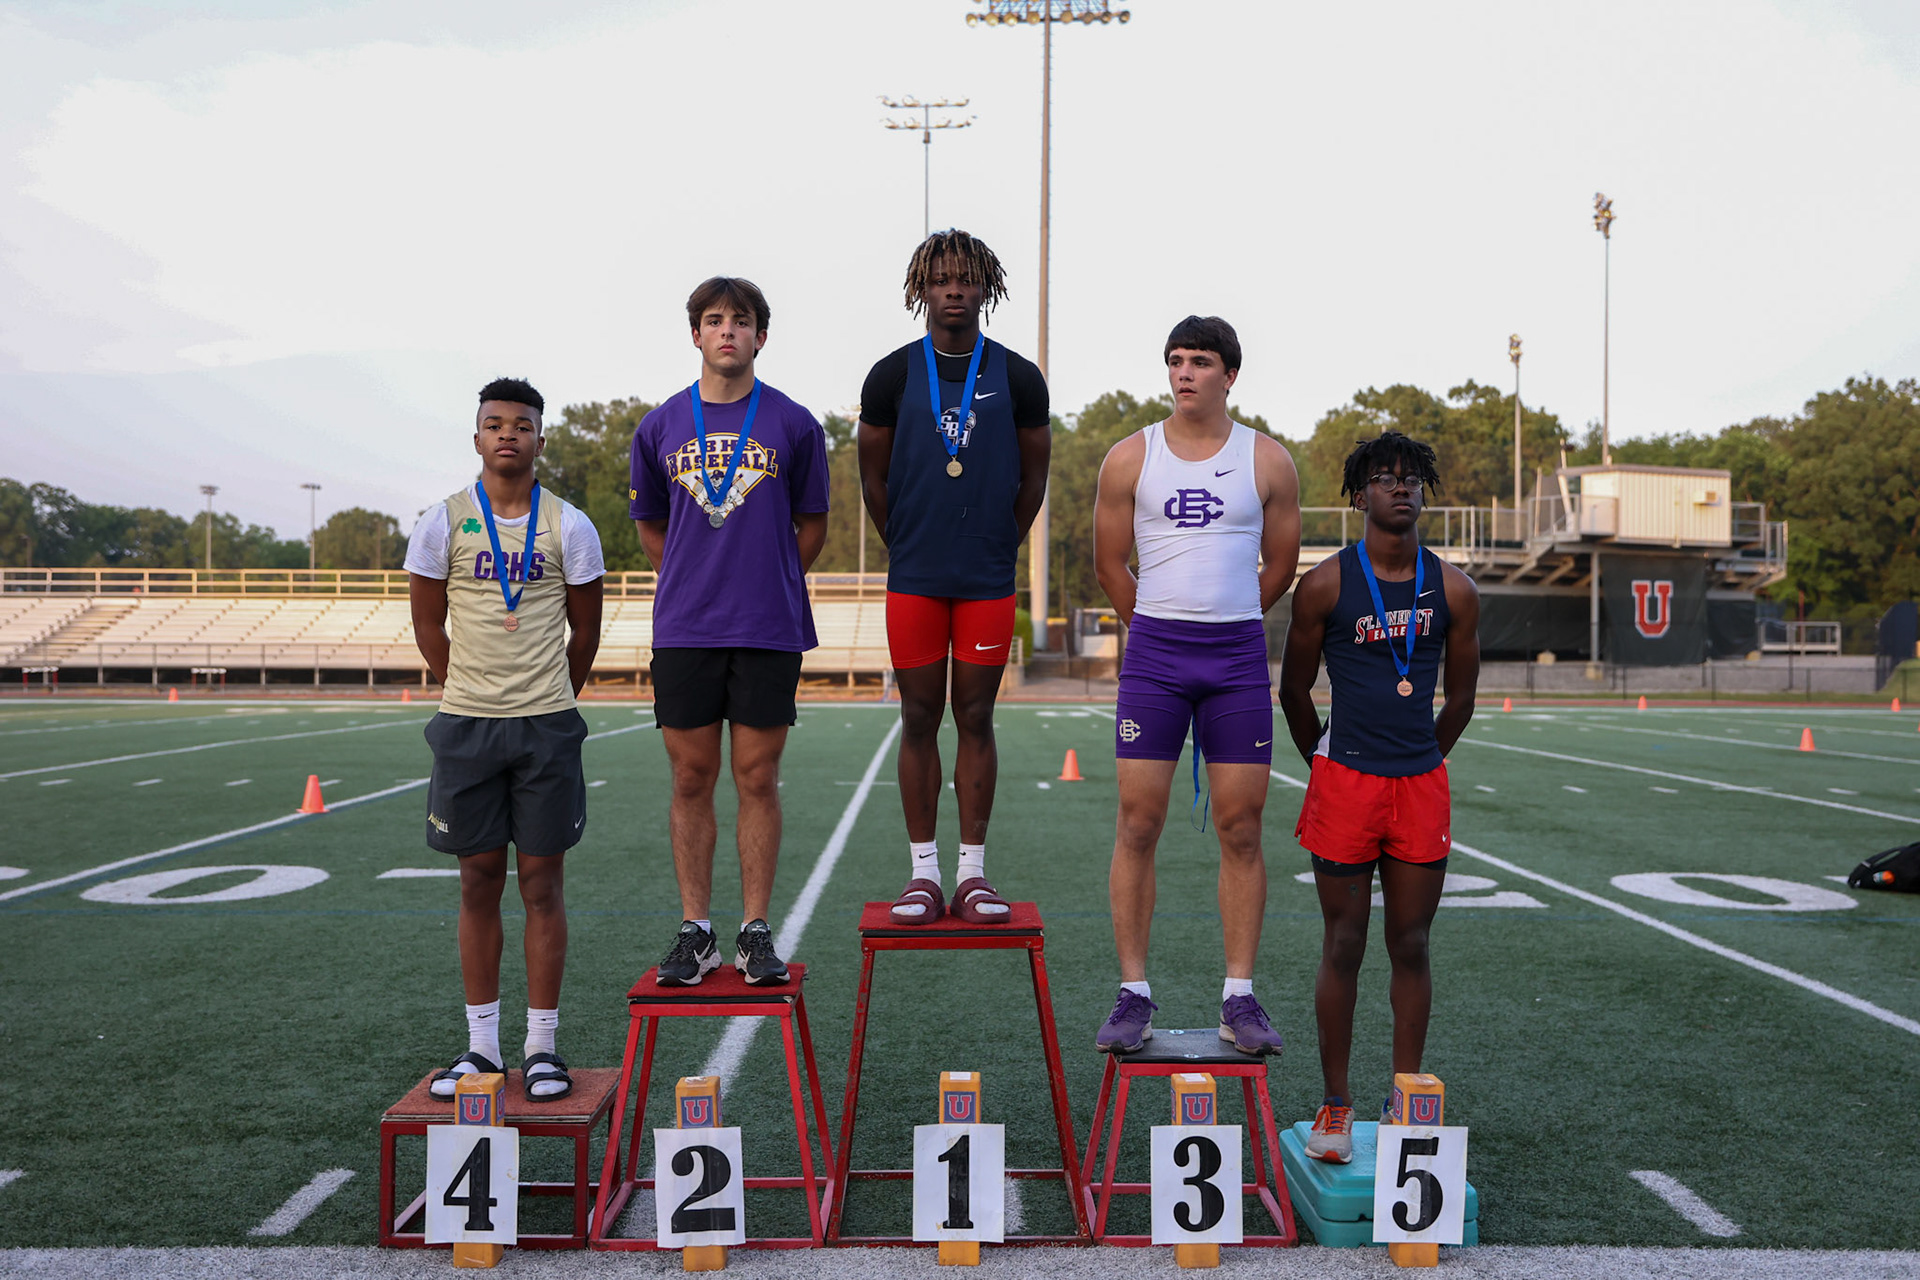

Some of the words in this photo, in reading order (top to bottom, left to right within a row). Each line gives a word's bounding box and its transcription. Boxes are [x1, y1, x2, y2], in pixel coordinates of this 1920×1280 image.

[682, 440, 757, 454] CBHS
[666, 448, 778, 481] BASEBALL
[1376, 608, 1434, 636] NEDCT
[1631, 580, 1673, 638] U
[1373, 626, 1408, 641] EAGLE
[463, 1097, 487, 1122] U
[684, 1099, 708, 1124] U
[948, 1095, 972, 1119] U
[1185, 1096, 1209, 1121] U
[1413, 1097, 1437, 1122] U
[443, 1137, 498, 1231] 4
[671, 1145, 736, 1233] 2
[938, 1135, 974, 1229] 1
[1173, 1136, 1225, 1232] 3
[1392, 1137, 1443, 1232] 5
